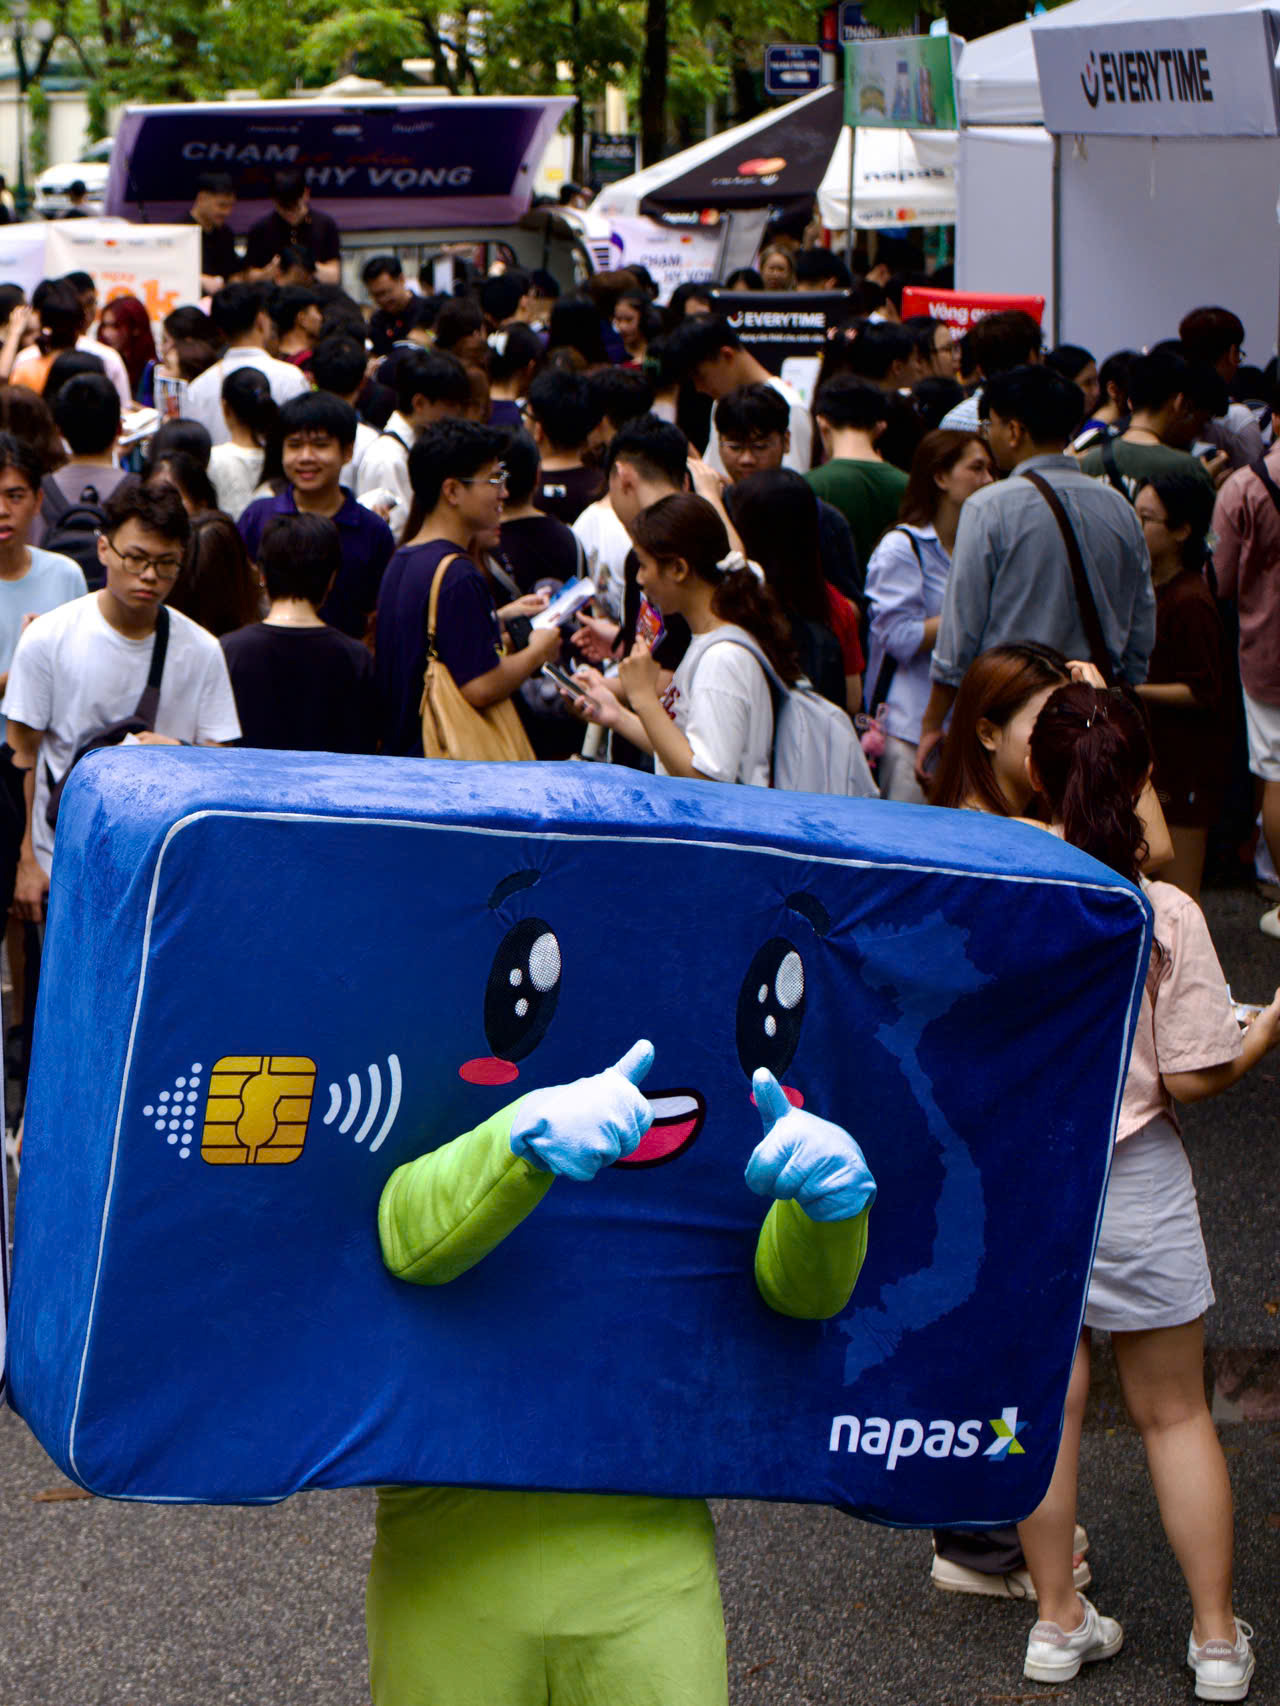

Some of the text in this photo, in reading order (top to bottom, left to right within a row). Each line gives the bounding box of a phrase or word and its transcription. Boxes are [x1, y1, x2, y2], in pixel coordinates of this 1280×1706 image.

[1099, 48, 1214, 103] EVERYTIME
[182, 142, 301, 164] CHẠM
[304, 165, 474, 191] HY VỌNG
[744, 311, 826, 329] EVERYTIME
[928, 301, 969, 325] Vòng
[829, 1415, 983, 1470] napas
